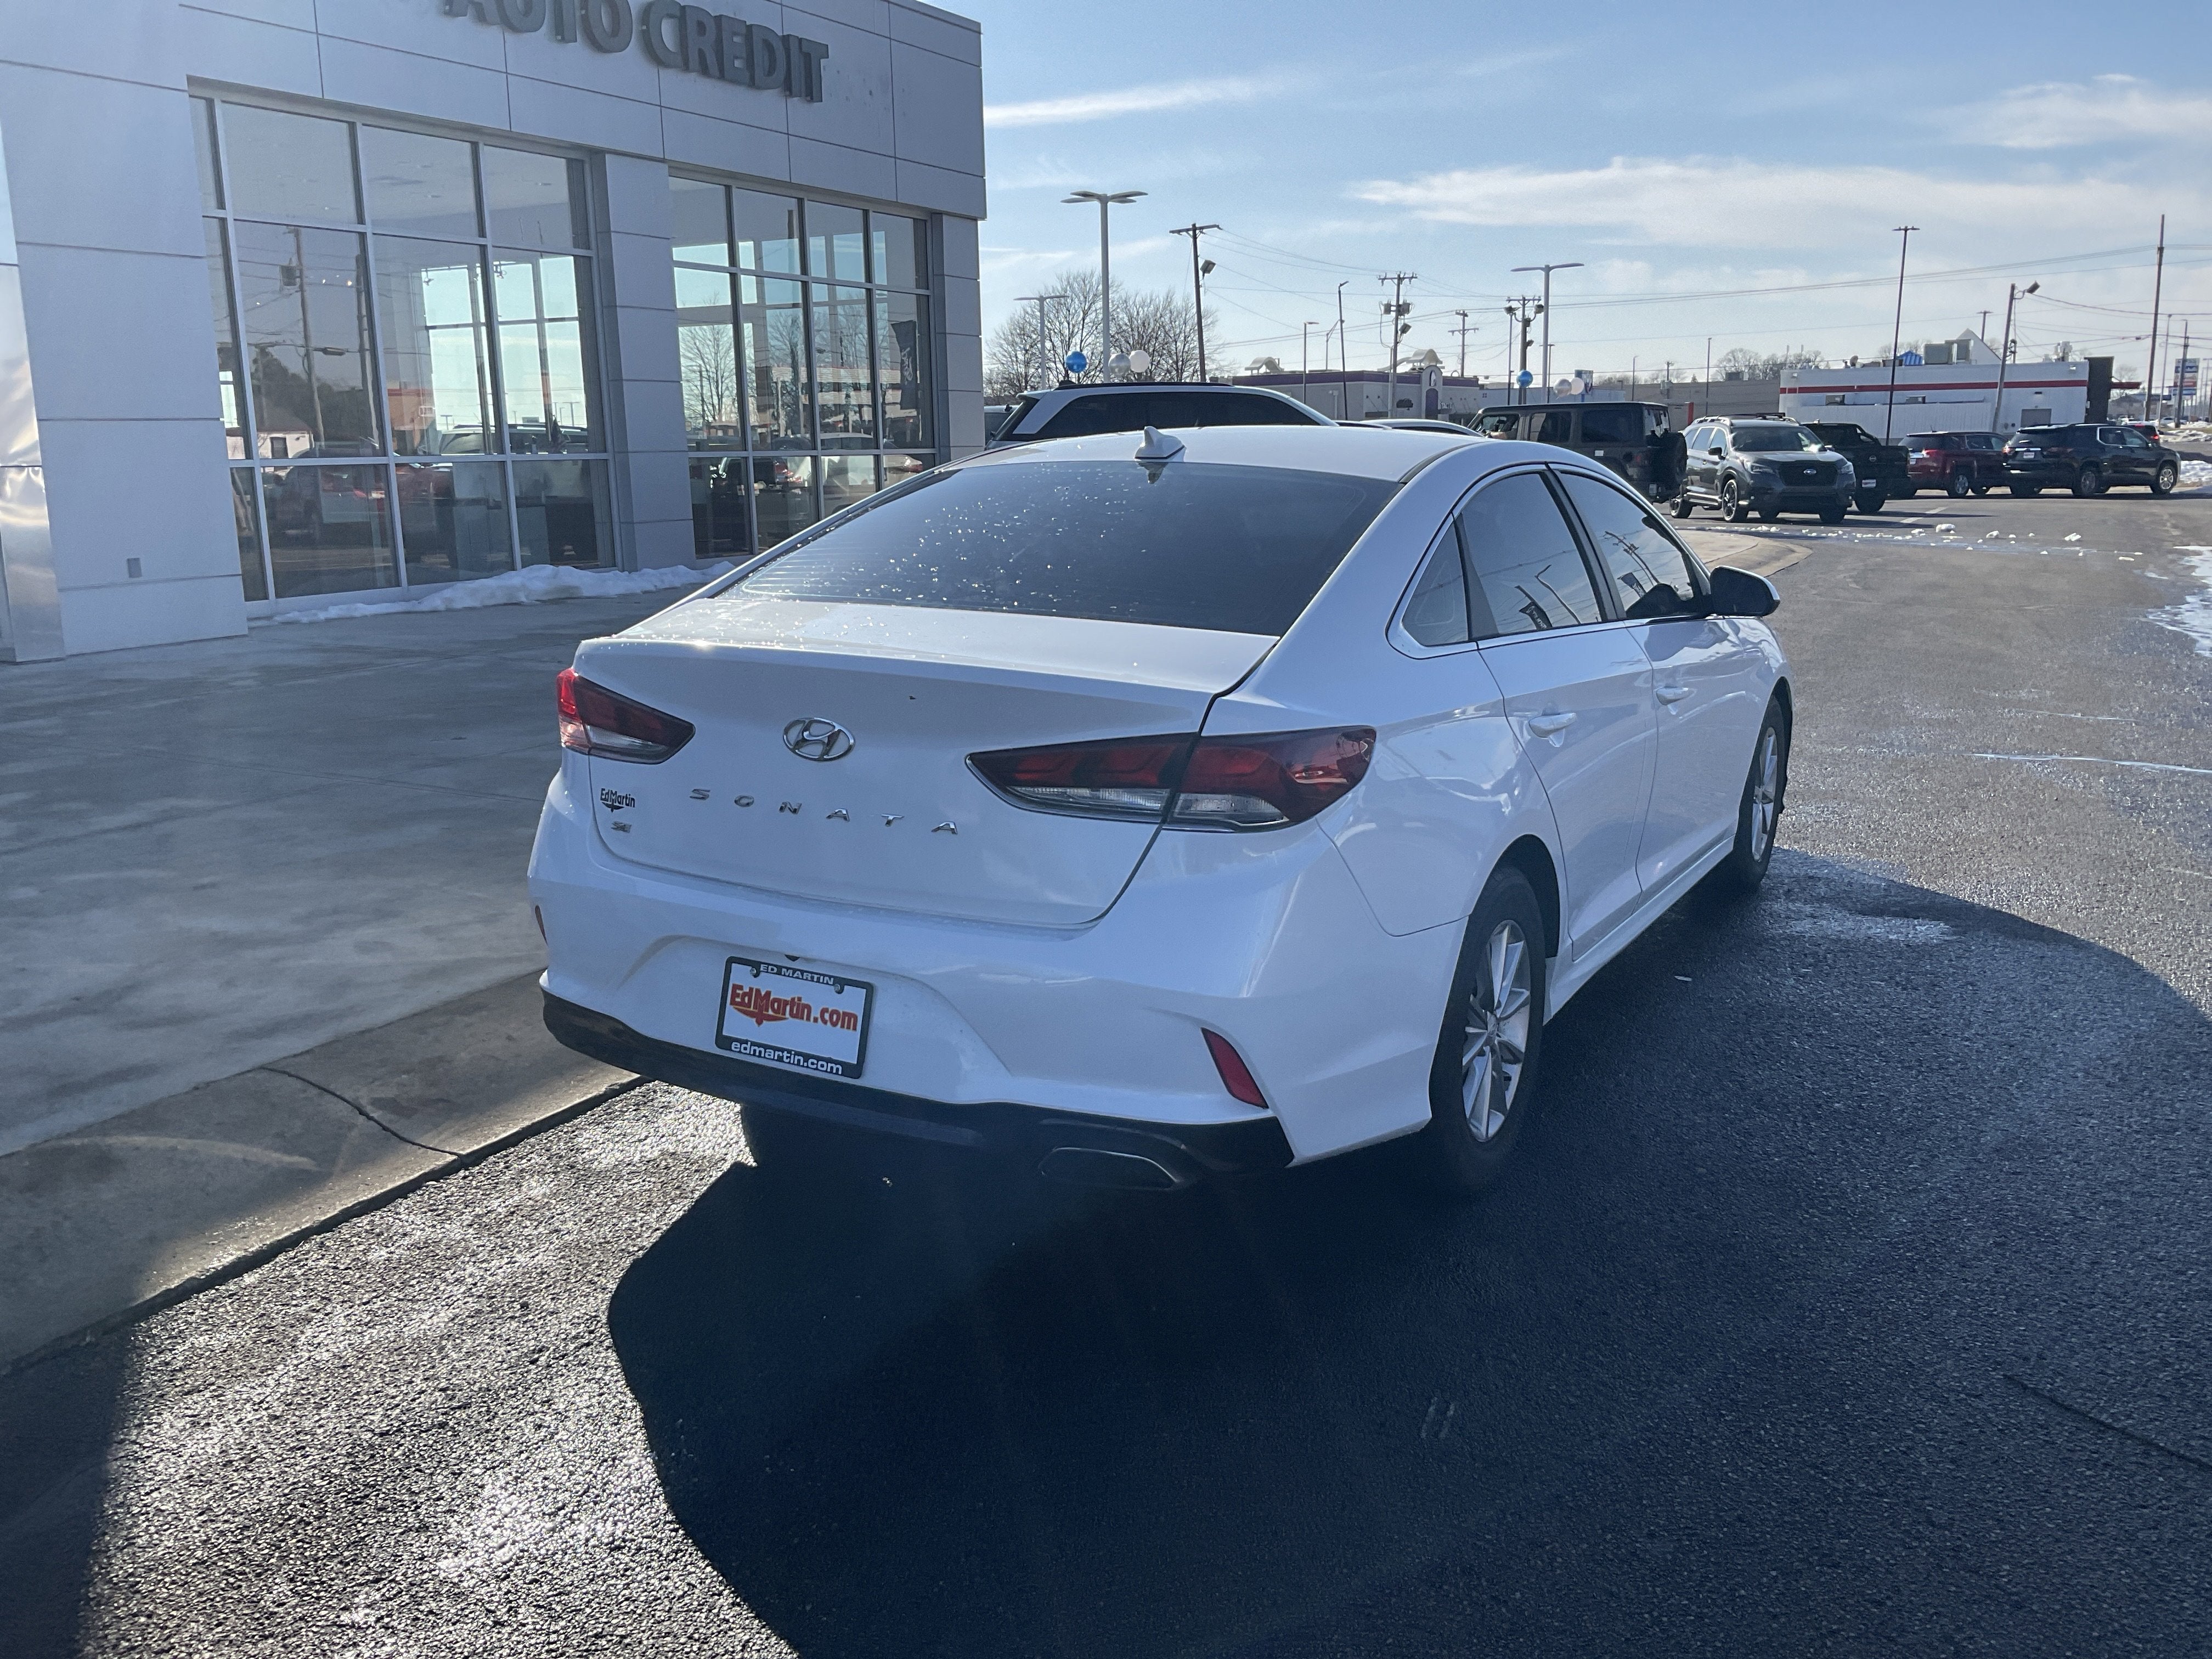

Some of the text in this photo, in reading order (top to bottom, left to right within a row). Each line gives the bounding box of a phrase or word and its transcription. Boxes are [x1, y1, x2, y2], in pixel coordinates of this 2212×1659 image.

[640, 0, 829, 103] CREDIT
[611, 821, 632, 833] SE
[689, 788, 958, 836] SONATA
[760, 964, 834, 985] ED MARTIN
[730, 983, 858, 1031] EdMartin.com
[731, 1041, 842, 1075] edmartin.com
